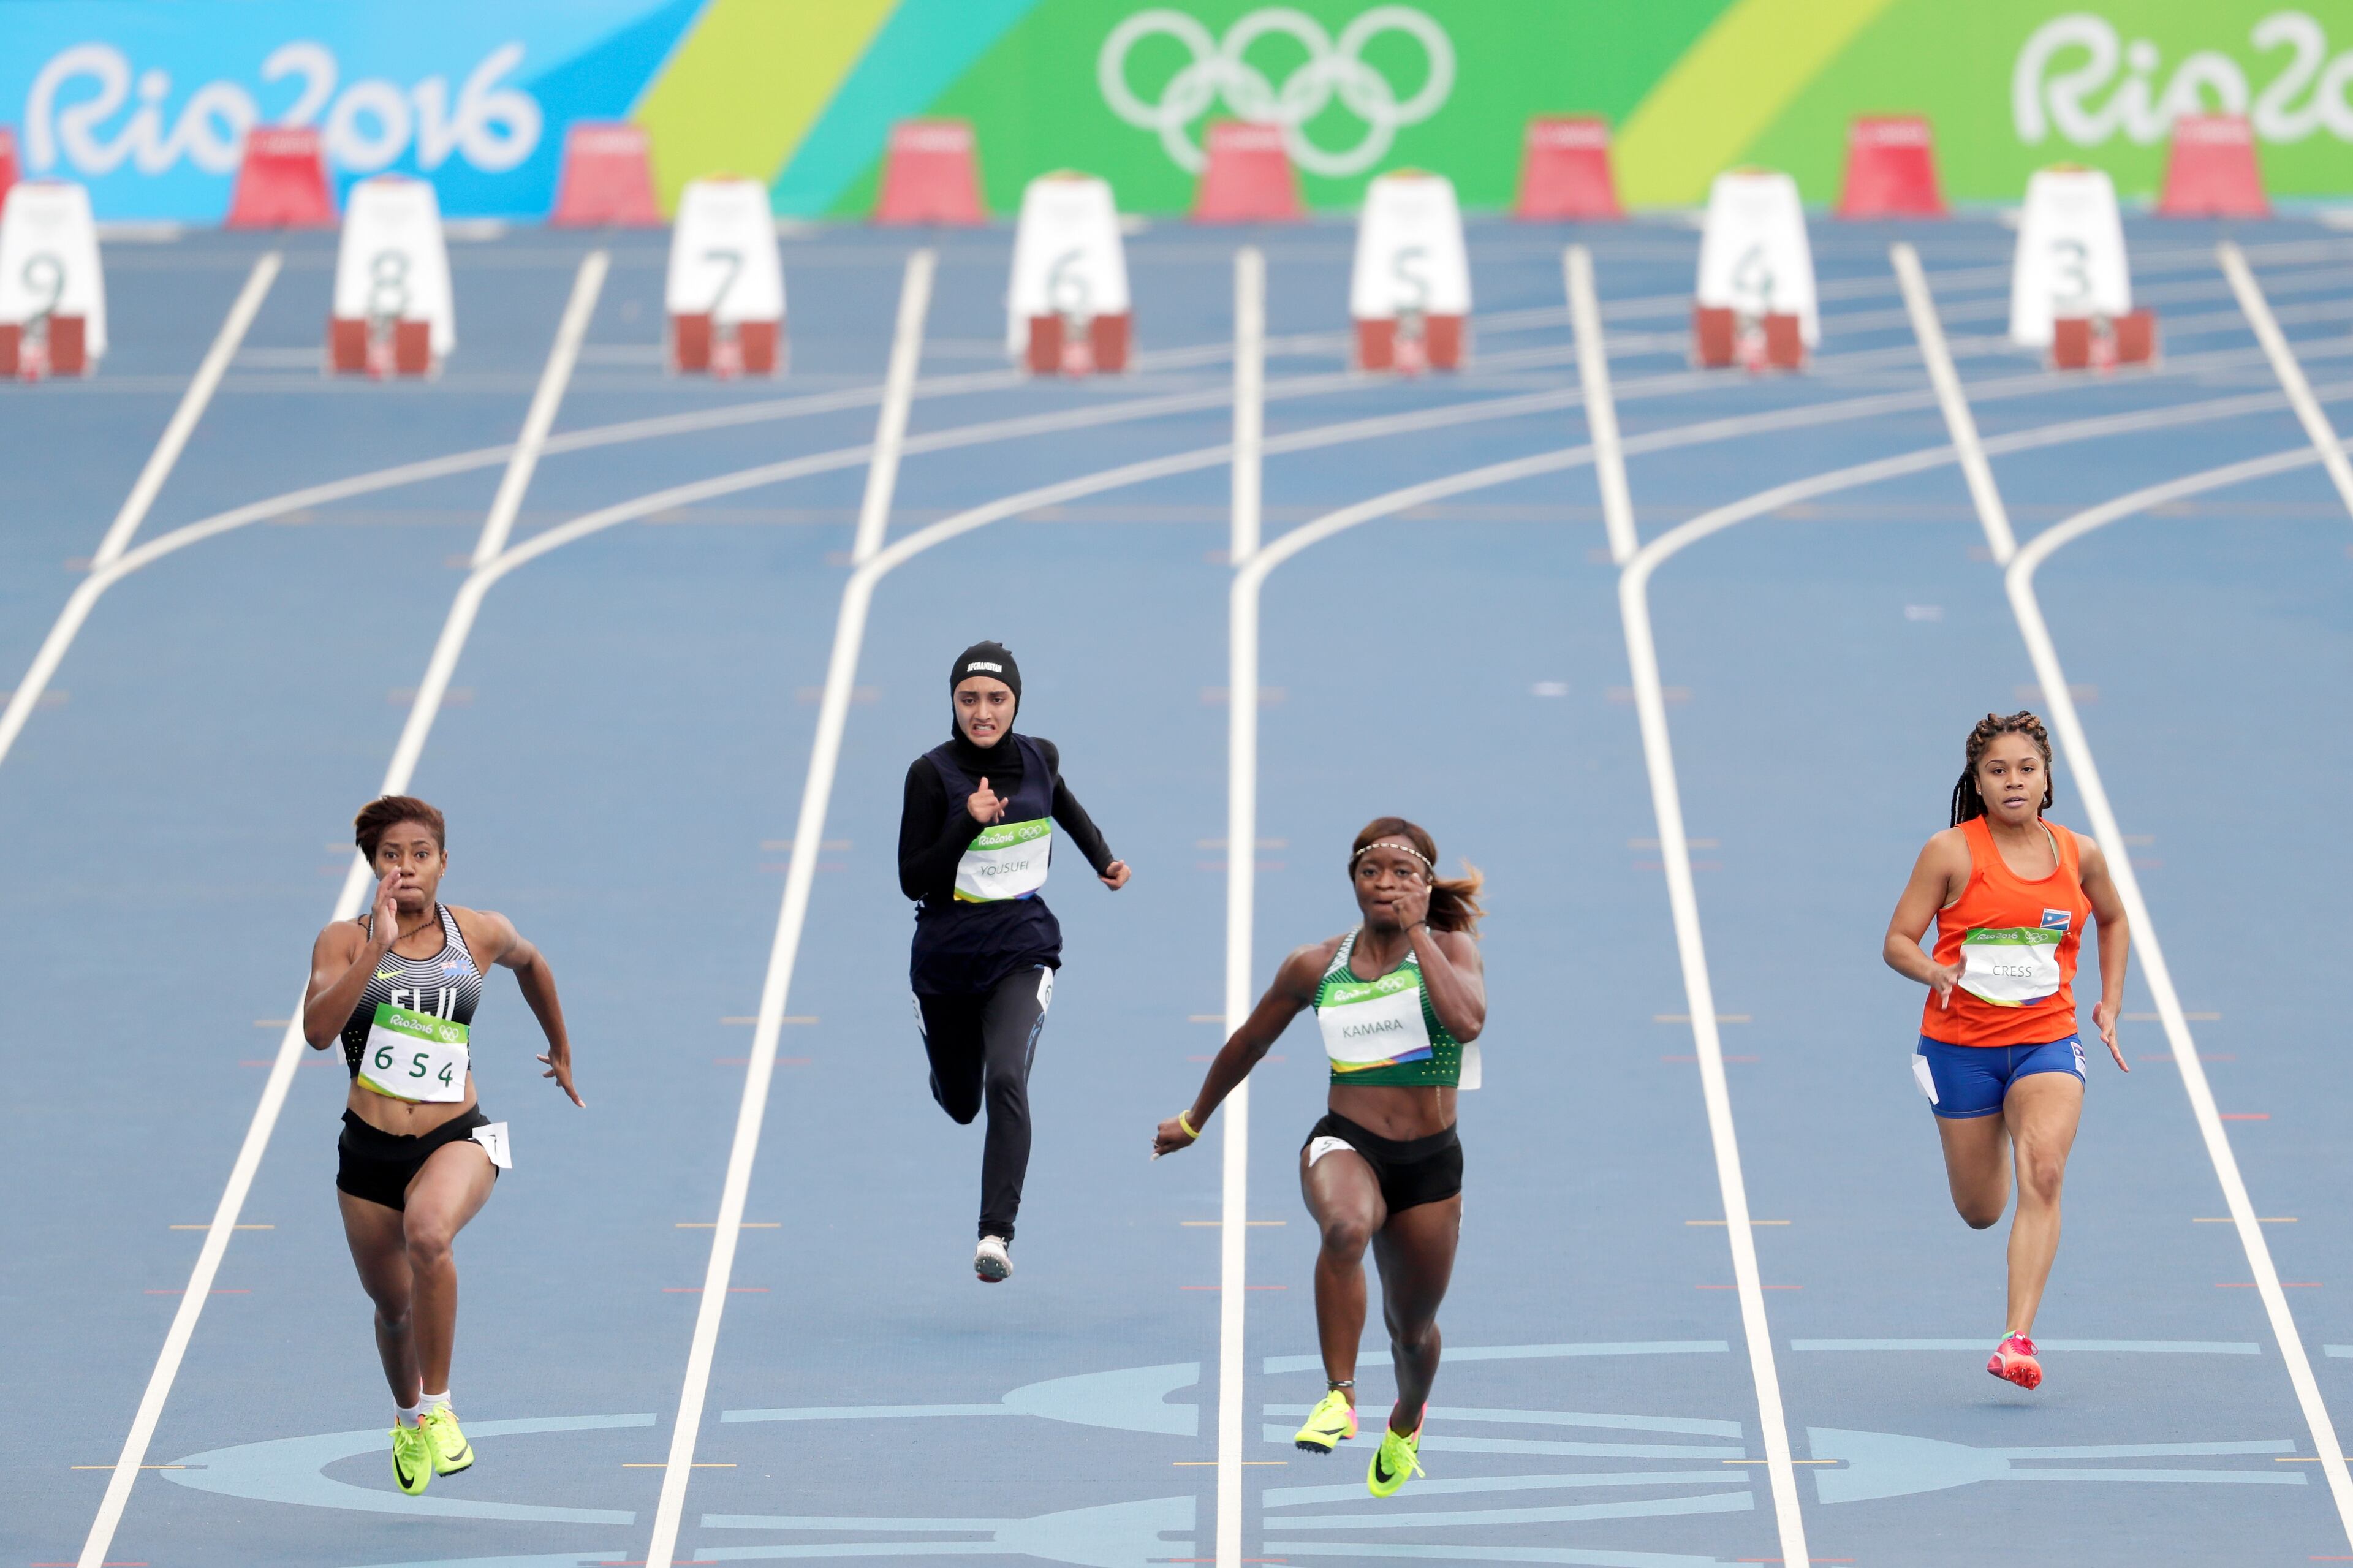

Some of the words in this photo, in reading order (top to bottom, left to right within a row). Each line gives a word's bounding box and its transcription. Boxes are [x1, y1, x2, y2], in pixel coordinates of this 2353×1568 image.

[22, 252, 65, 334] 9
[368, 250, 412, 319] 8
[702, 250, 744, 312] 7
[1047, 248, 1092, 315] 6
[1393, 247, 1432, 314] 5
[2048, 238, 2093, 308] 3
[967, 662, 1002, 673] AFGHANISTAN
[980, 861, 1029, 876] YOUSUFI
[1993, 965, 2032, 978] CRESS
[1342, 1019, 1403, 1039] KAMARA
